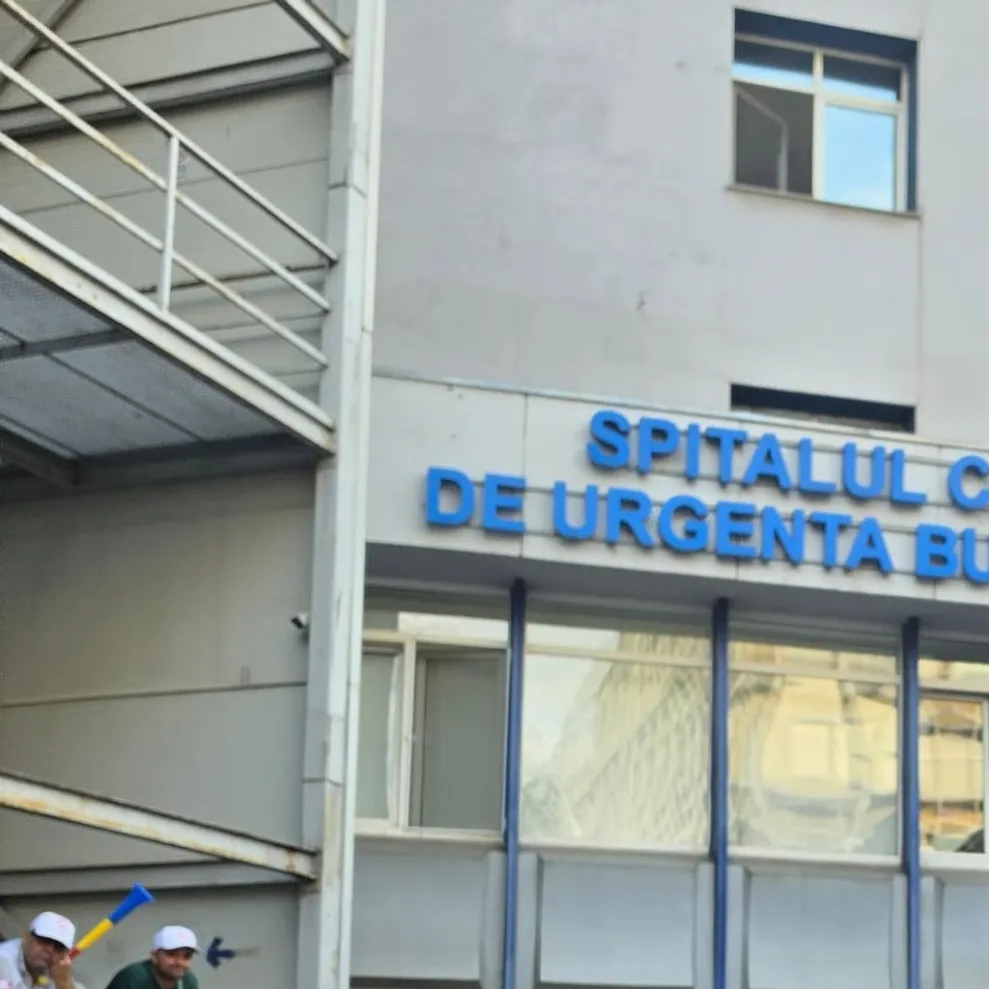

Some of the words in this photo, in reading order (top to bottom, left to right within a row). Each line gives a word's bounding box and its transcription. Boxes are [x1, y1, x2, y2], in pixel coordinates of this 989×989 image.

[586, 410, 927, 506] SPITALUL
[425, 467, 526, 534] DE
[552, 481, 893, 574] URGENTA
